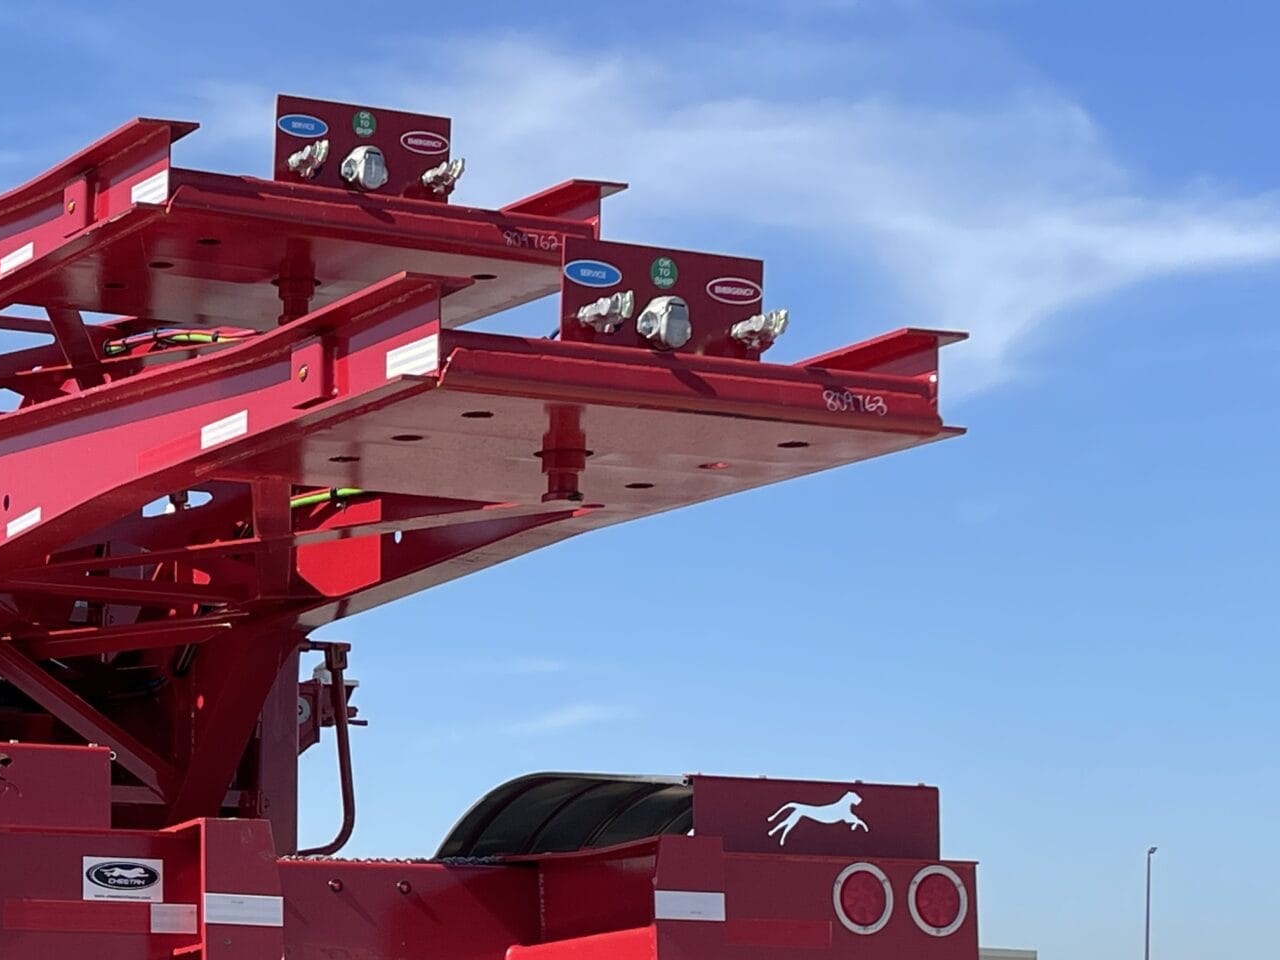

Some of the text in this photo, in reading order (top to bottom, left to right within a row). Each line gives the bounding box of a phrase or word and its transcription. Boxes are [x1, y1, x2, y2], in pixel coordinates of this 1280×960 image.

[359, 112, 371, 120] OK
[291, 120, 315, 131] SERVICE
[359, 120, 370, 128] TO
[355, 127, 373, 135] SHIP
[407, 137, 442, 148] EMERGENCY
[658, 258, 671, 267] OK
[579, 268, 607, 280] SERVICE
[658, 268, 670, 276] TO
[653, 276, 674, 286] SHIP
[714, 285, 755, 297] EMERGENCY
[107, 877, 145, 885] CHEETAH
